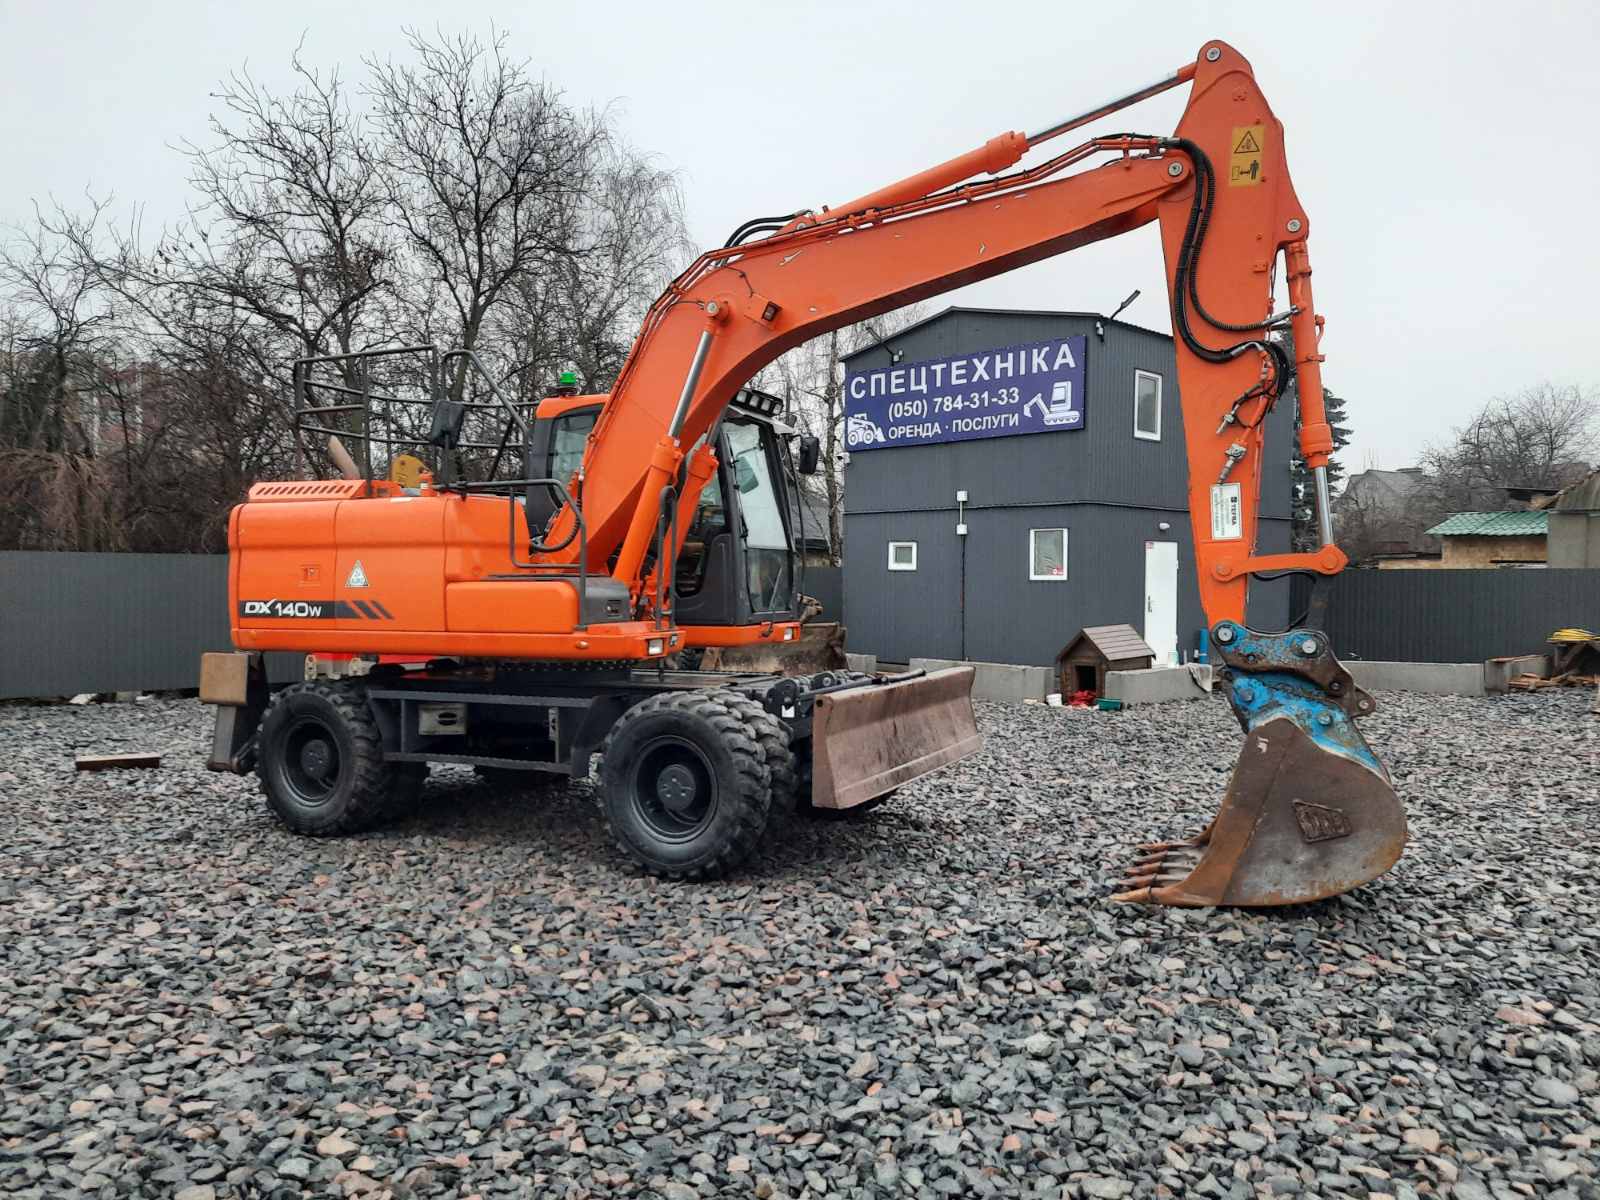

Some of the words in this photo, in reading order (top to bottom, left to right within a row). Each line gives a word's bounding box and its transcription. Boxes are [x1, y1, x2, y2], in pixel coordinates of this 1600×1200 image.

[850, 343, 1077, 399] СПЕЦТЕХНІКА
[888, 401, 928, 422] (050)
[933, 387, 1020, 414] 784-31-33
[888, 423, 942, 440] ОРЕНДА
[952, 413, 1020, 433] ПОСЛУГИ
